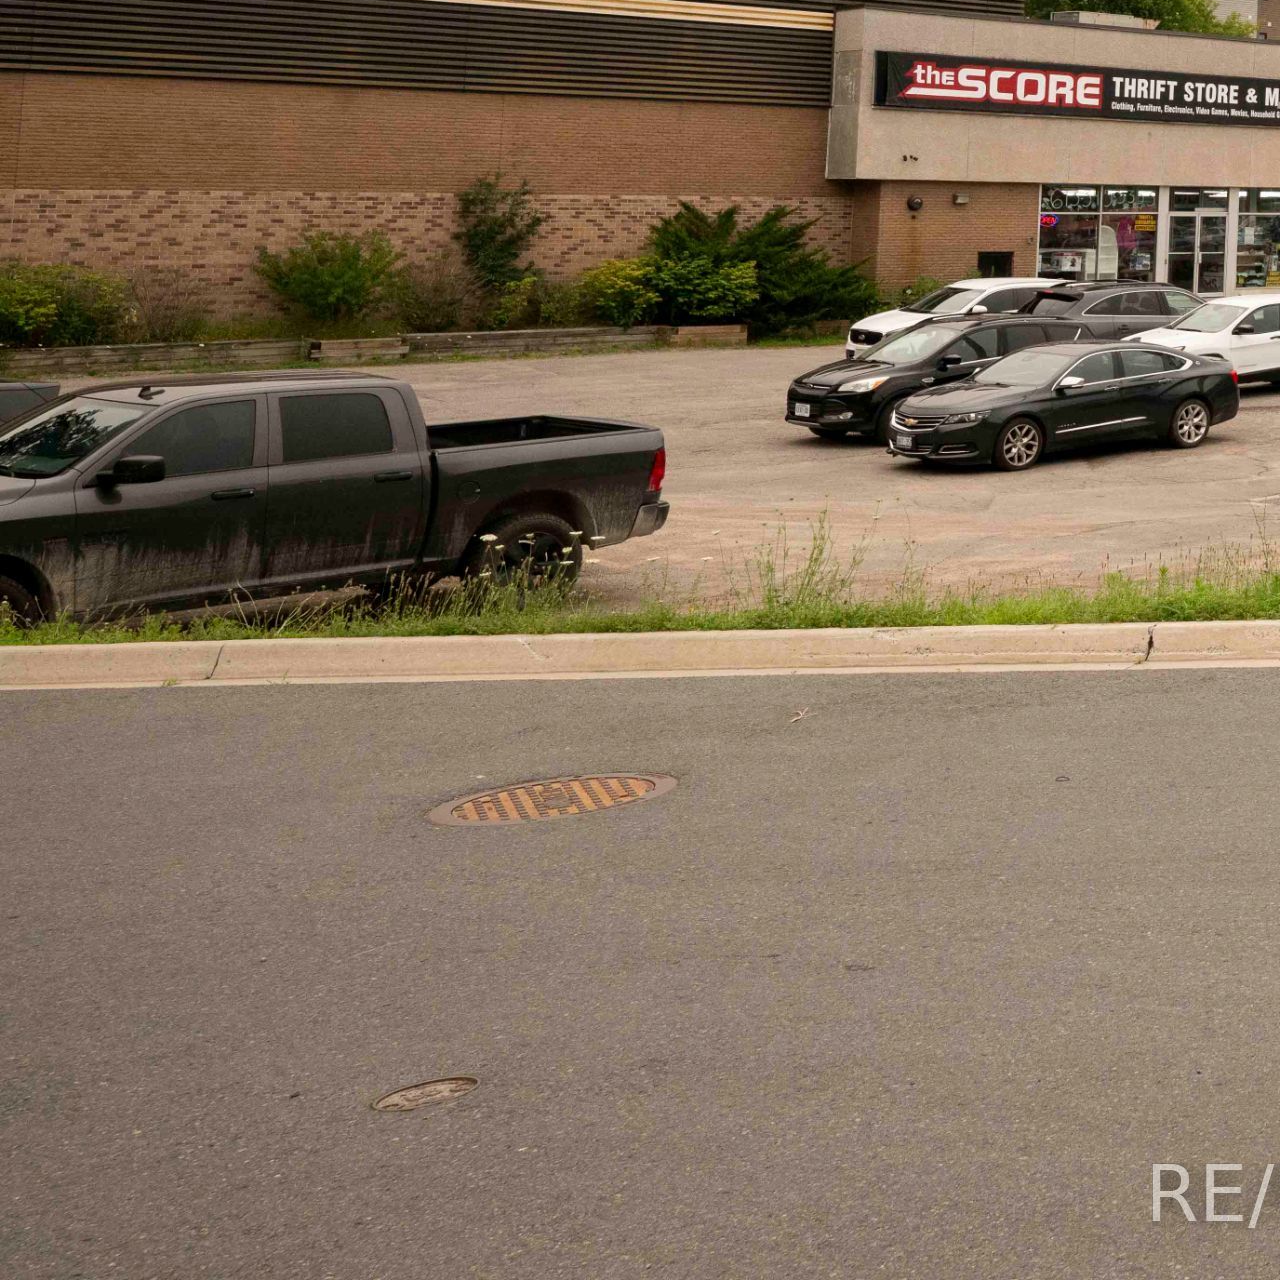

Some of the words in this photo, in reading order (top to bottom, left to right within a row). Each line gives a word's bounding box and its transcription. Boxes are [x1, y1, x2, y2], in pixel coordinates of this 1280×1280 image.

[1112, 76, 1178, 101] THRIFT
[1183, 81, 1240, 105] STORE
[1245, 87, 1259, 104] &
[1111, 101, 1136, 112] Clothing,
[1136, 102, 1163, 114] Furniture,
[1164, 104, 1195, 116] Electronics,
[1195, 106, 1210, 115] Video
[1211, 107, 1230, 117] Games,
[1230, 108, 1250, 118] Movies,
[1250, 109, 1276, 119] Household
